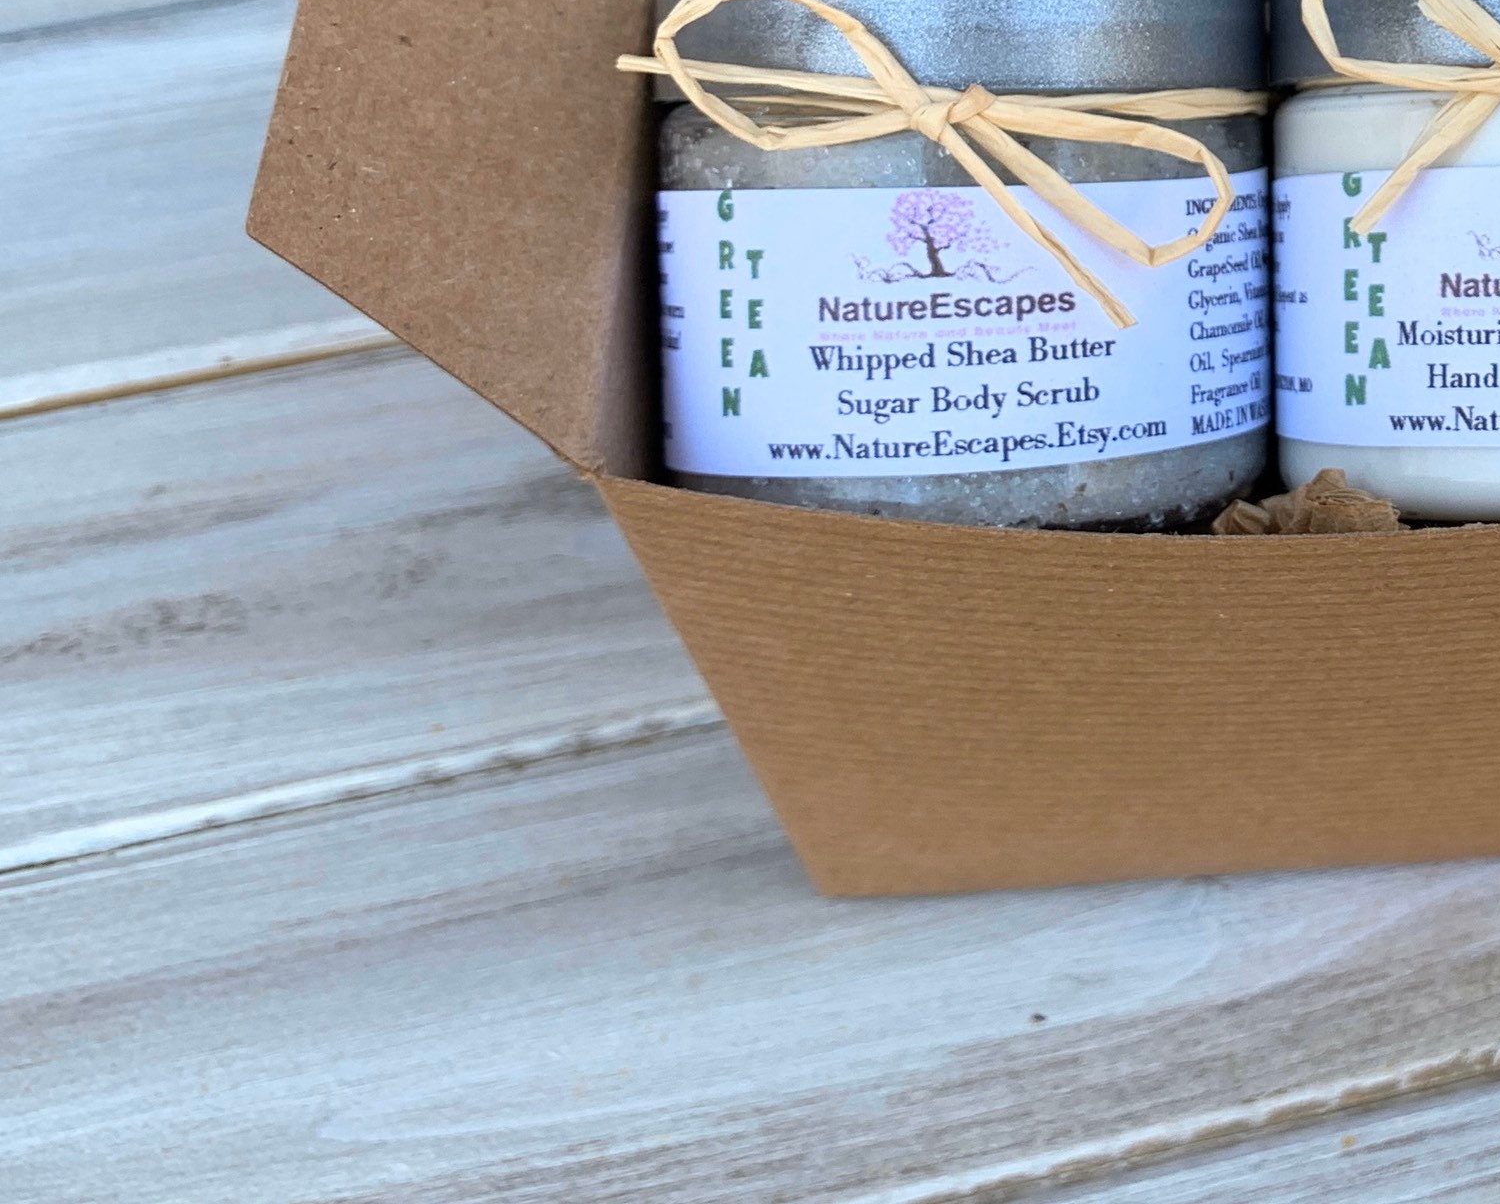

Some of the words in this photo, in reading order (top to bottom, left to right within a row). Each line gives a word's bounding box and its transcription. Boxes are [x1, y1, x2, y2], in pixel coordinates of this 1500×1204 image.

[1187, 252, 1249, 283] GrapeSeed
[717, 189, 741, 416] GREEN
[746, 249, 770, 377] TEA
[818, 290, 1077, 322] NatureEscapes
[1188, 285, 1242, 315] Glycerin,
[1367, 232, 1391, 369] TEA
[1190, 312, 1252, 341] Chamomile
[809, 342, 936, 380] Whipped
[947, 339, 1017, 366] Shea
[1028, 335, 1116, 362] Butter
[1189, 350, 1215, 373] Oil,
[1427, 362, 1499, 389] Hand
[838, 389, 921, 424] Sugar
[931, 384, 1007, 418] Body
[1017, 377, 1100, 407] Scrub
[1191, 381, 1248, 407] Fragrance
[1191, 408, 1234, 436] MADE
[1236, 404, 1248, 426] IN
[768, 416, 1168, 462] www.NatureEscapes.Etsy.com
